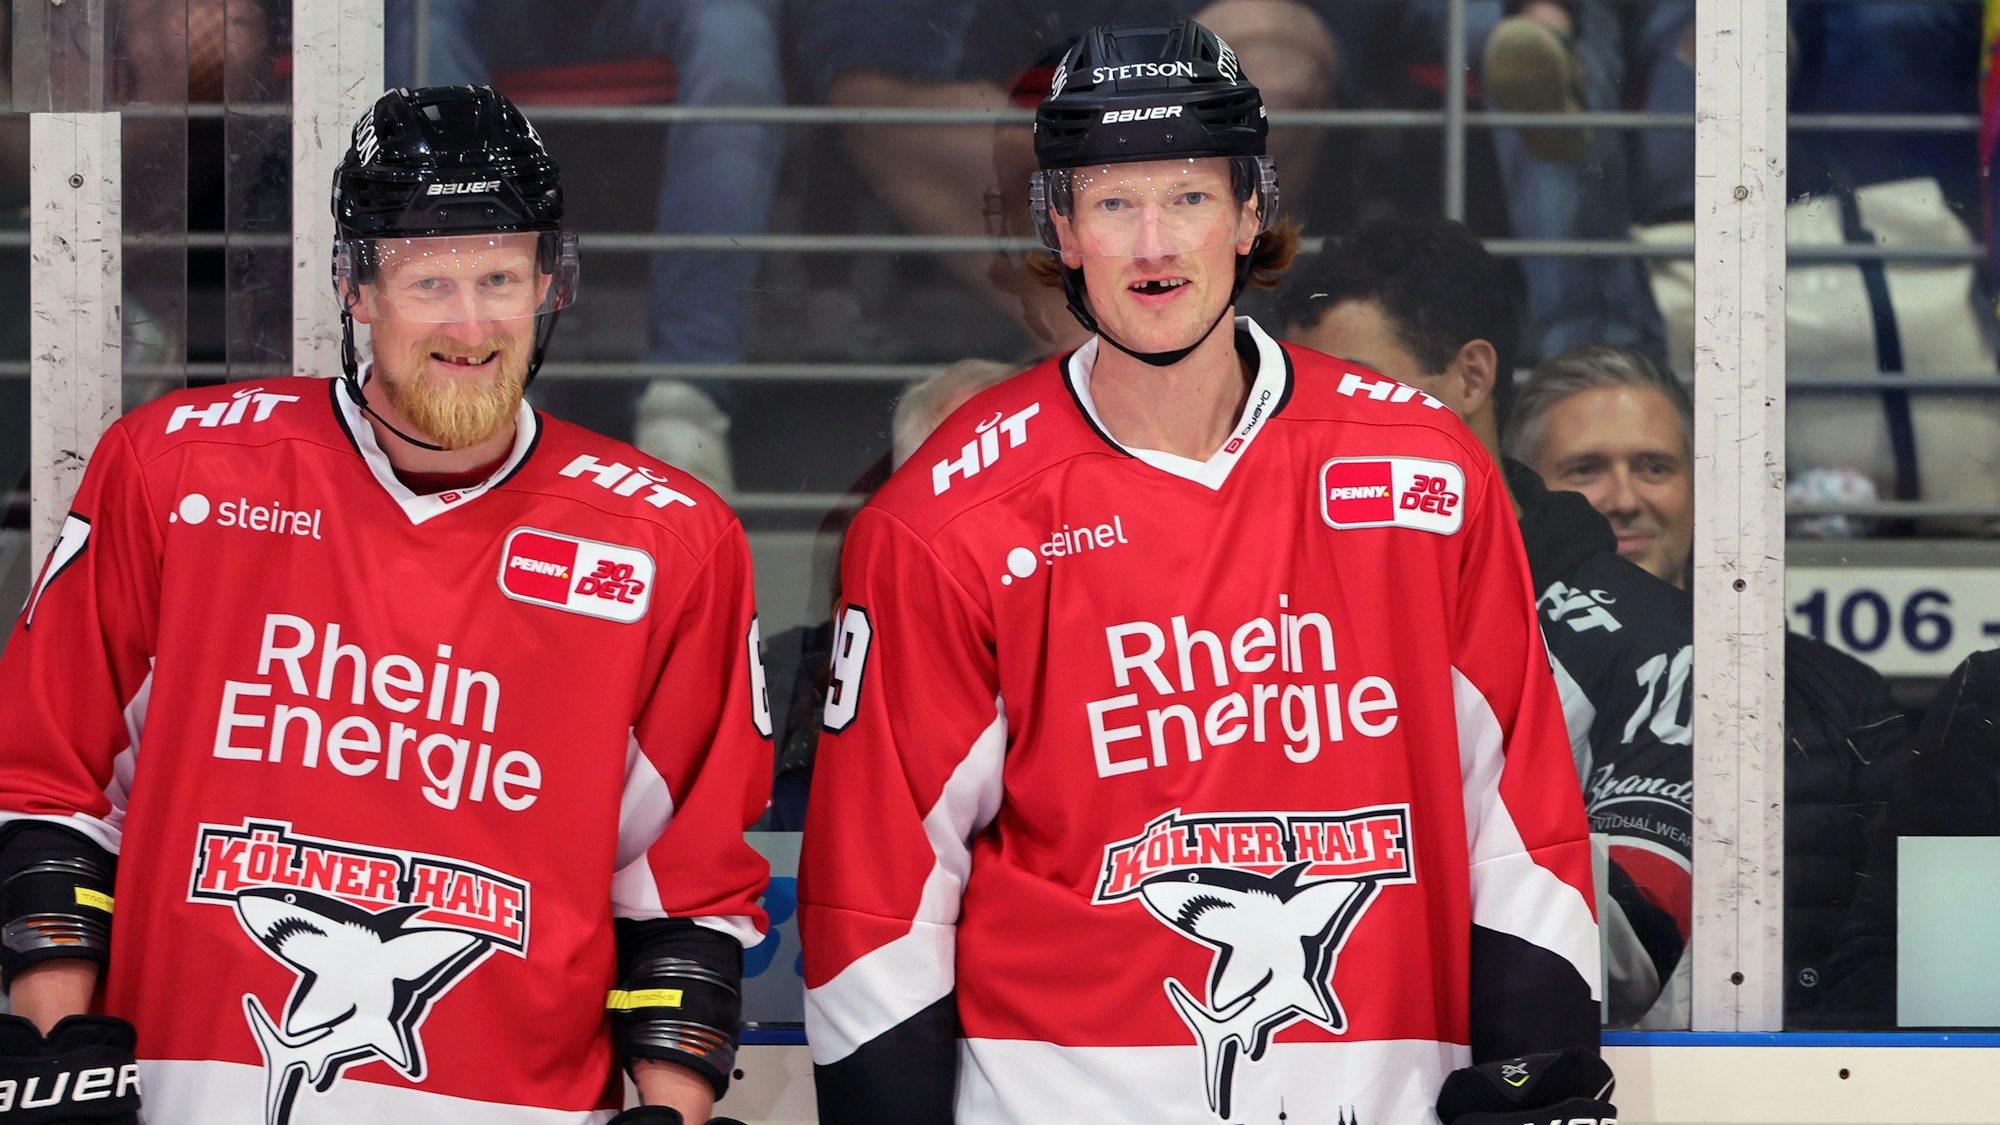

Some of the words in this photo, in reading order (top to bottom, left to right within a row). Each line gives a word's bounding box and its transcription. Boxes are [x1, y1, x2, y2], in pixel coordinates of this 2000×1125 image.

[1101, 105, 1183, 124] BAUER
[426, 180, 501, 196] BAUER
[165, 387, 300, 434] HIT
[932, 402, 1040, 496] HIT
[558, 454, 697, 509] HIT
[1399, 492, 1452, 516] DEL
[1409, 474, 1447, 494] 30
[216, 497, 322, 540] steinel
[574, 576, 635, 604] DEL
[592, 560, 634, 581] 30
[1105, 593, 1336, 696] Rhein
[1794, 587, 1954, 654] 106
[257, 613, 500, 733] Rhein
[212, 680, 542, 811] Energie
[1086, 676, 1398, 778] Energie
[1107, 821, 1283, 895] KÖLNER
[1295, 817, 1405, 872] HAIE
[199, 831, 399, 900] KÖLNER
[413, 866, 523, 943] HAIE
